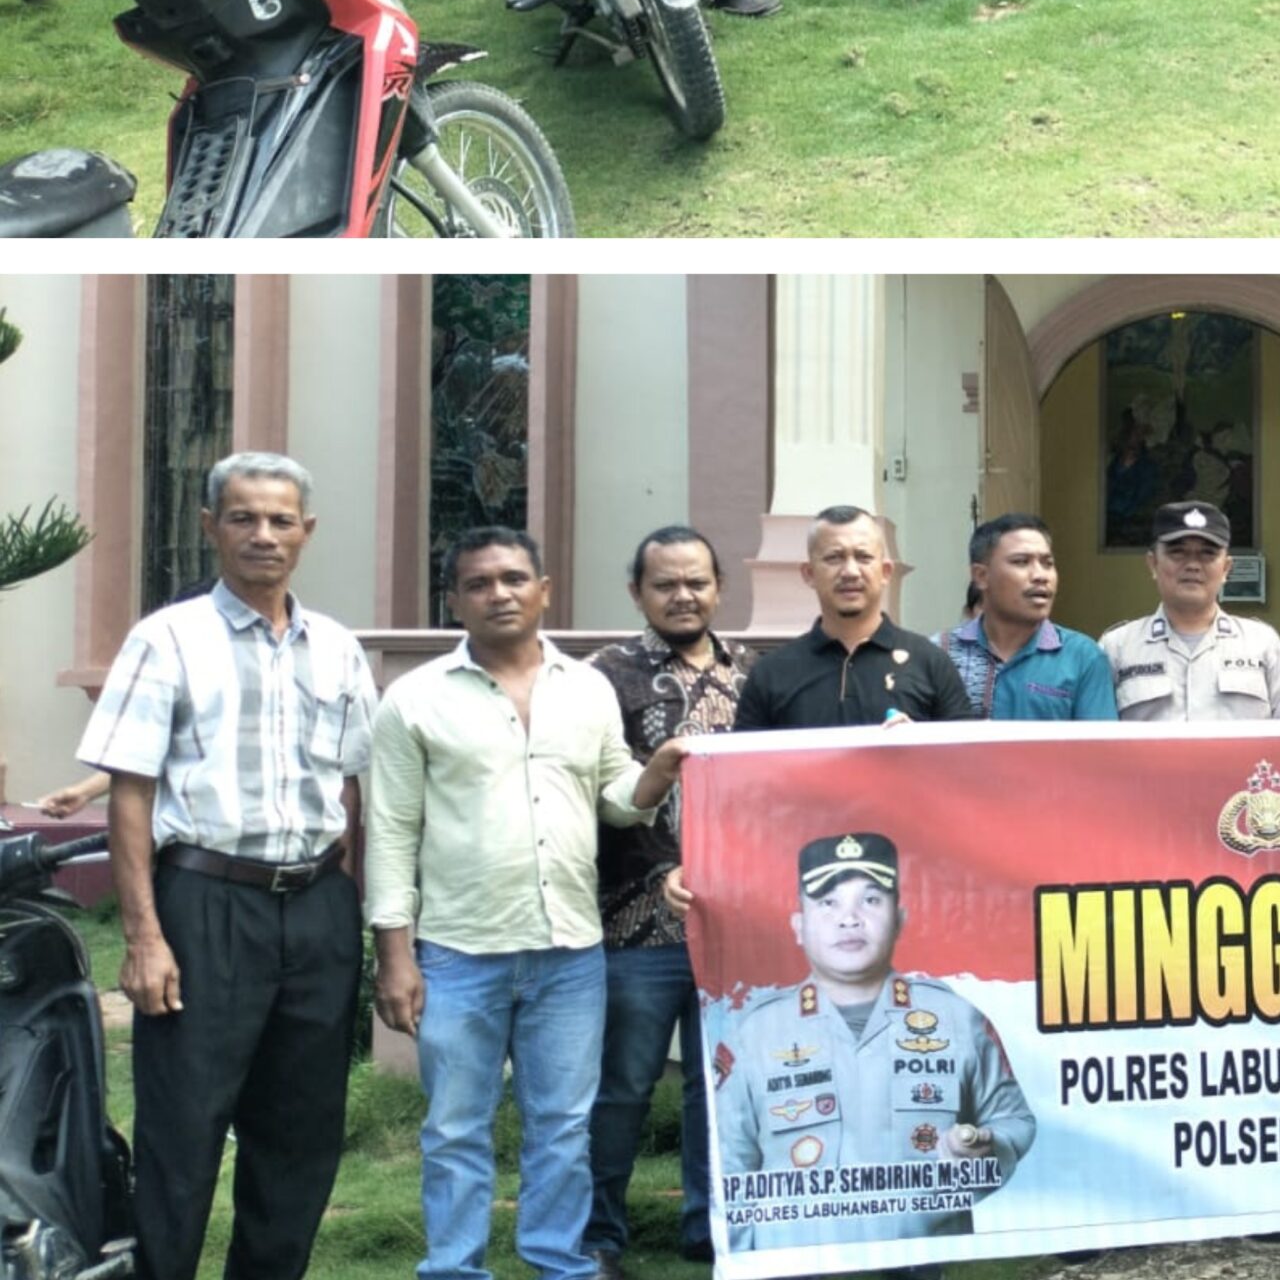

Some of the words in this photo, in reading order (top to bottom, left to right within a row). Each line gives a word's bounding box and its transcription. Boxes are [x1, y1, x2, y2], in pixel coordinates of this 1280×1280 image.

[894, 1058, 955, 1074] POLRI
[1060, 1052, 1189, 1105] POLRES
[745, 1171, 804, 1200] ADITYA
[840, 1163, 933, 1192] SEMBIRING
[727, 1203, 798, 1225] KAPOLRES
[803, 1197, 906, 1219] LABUHANBATU
[911, 1193, 972, 1212] SELATAN
